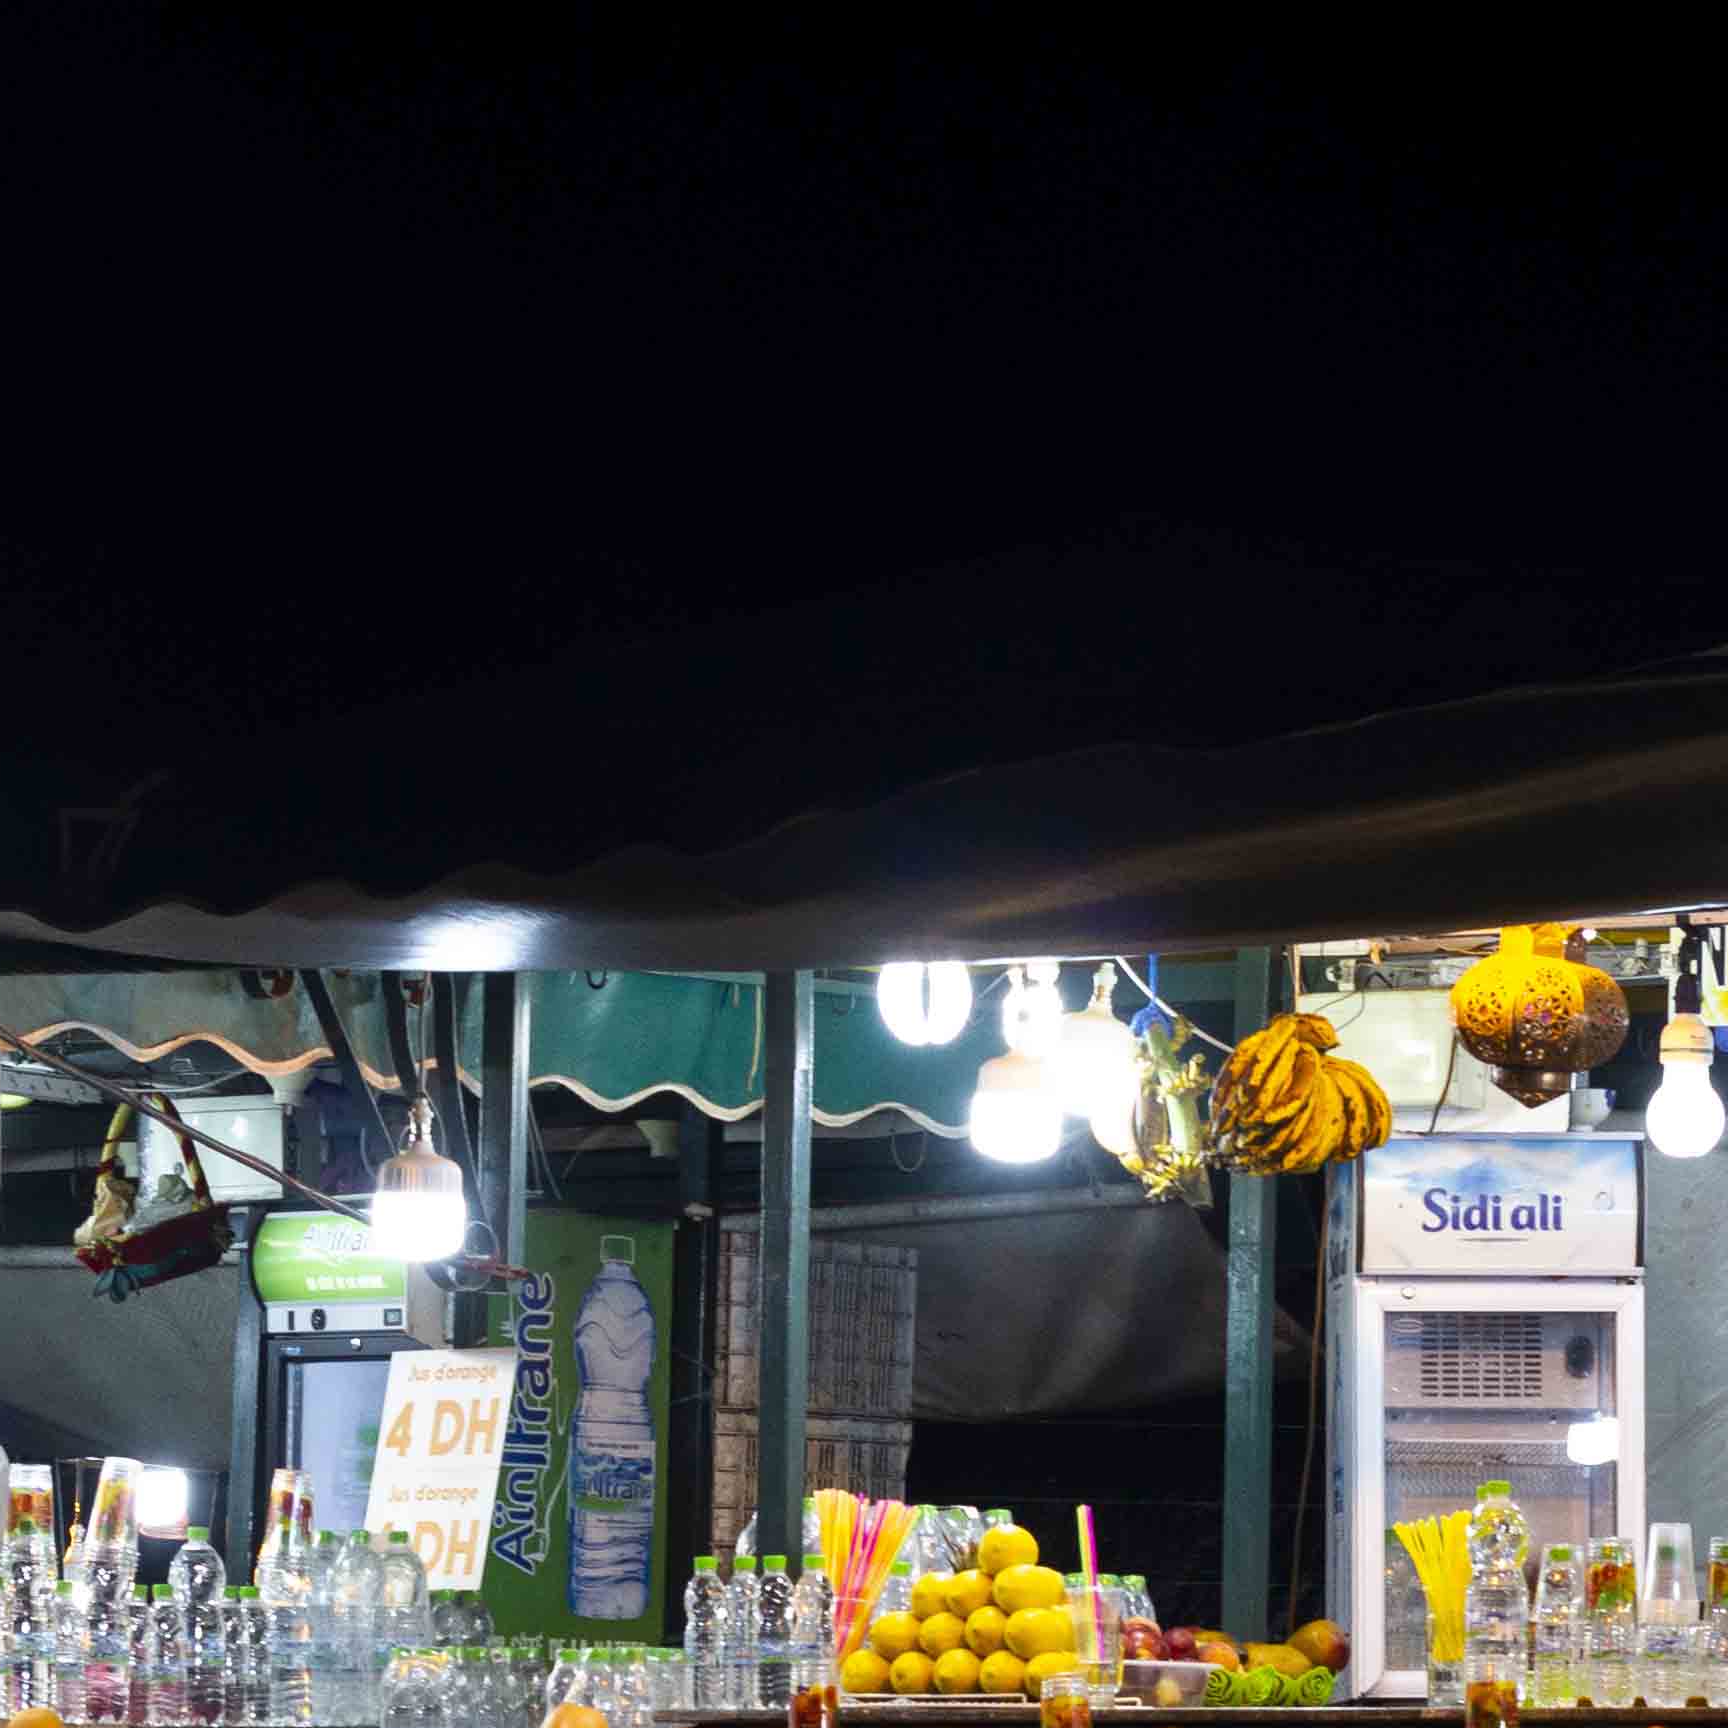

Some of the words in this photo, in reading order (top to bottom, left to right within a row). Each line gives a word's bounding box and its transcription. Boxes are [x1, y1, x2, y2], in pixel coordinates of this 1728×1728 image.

[1422, 1186, 1503, 1233] Sidi
[1510, 1192, 1565, 1232] ali
[384, 1399, 415, 1457] 4
[429, 1397, 501, 1457] DH
